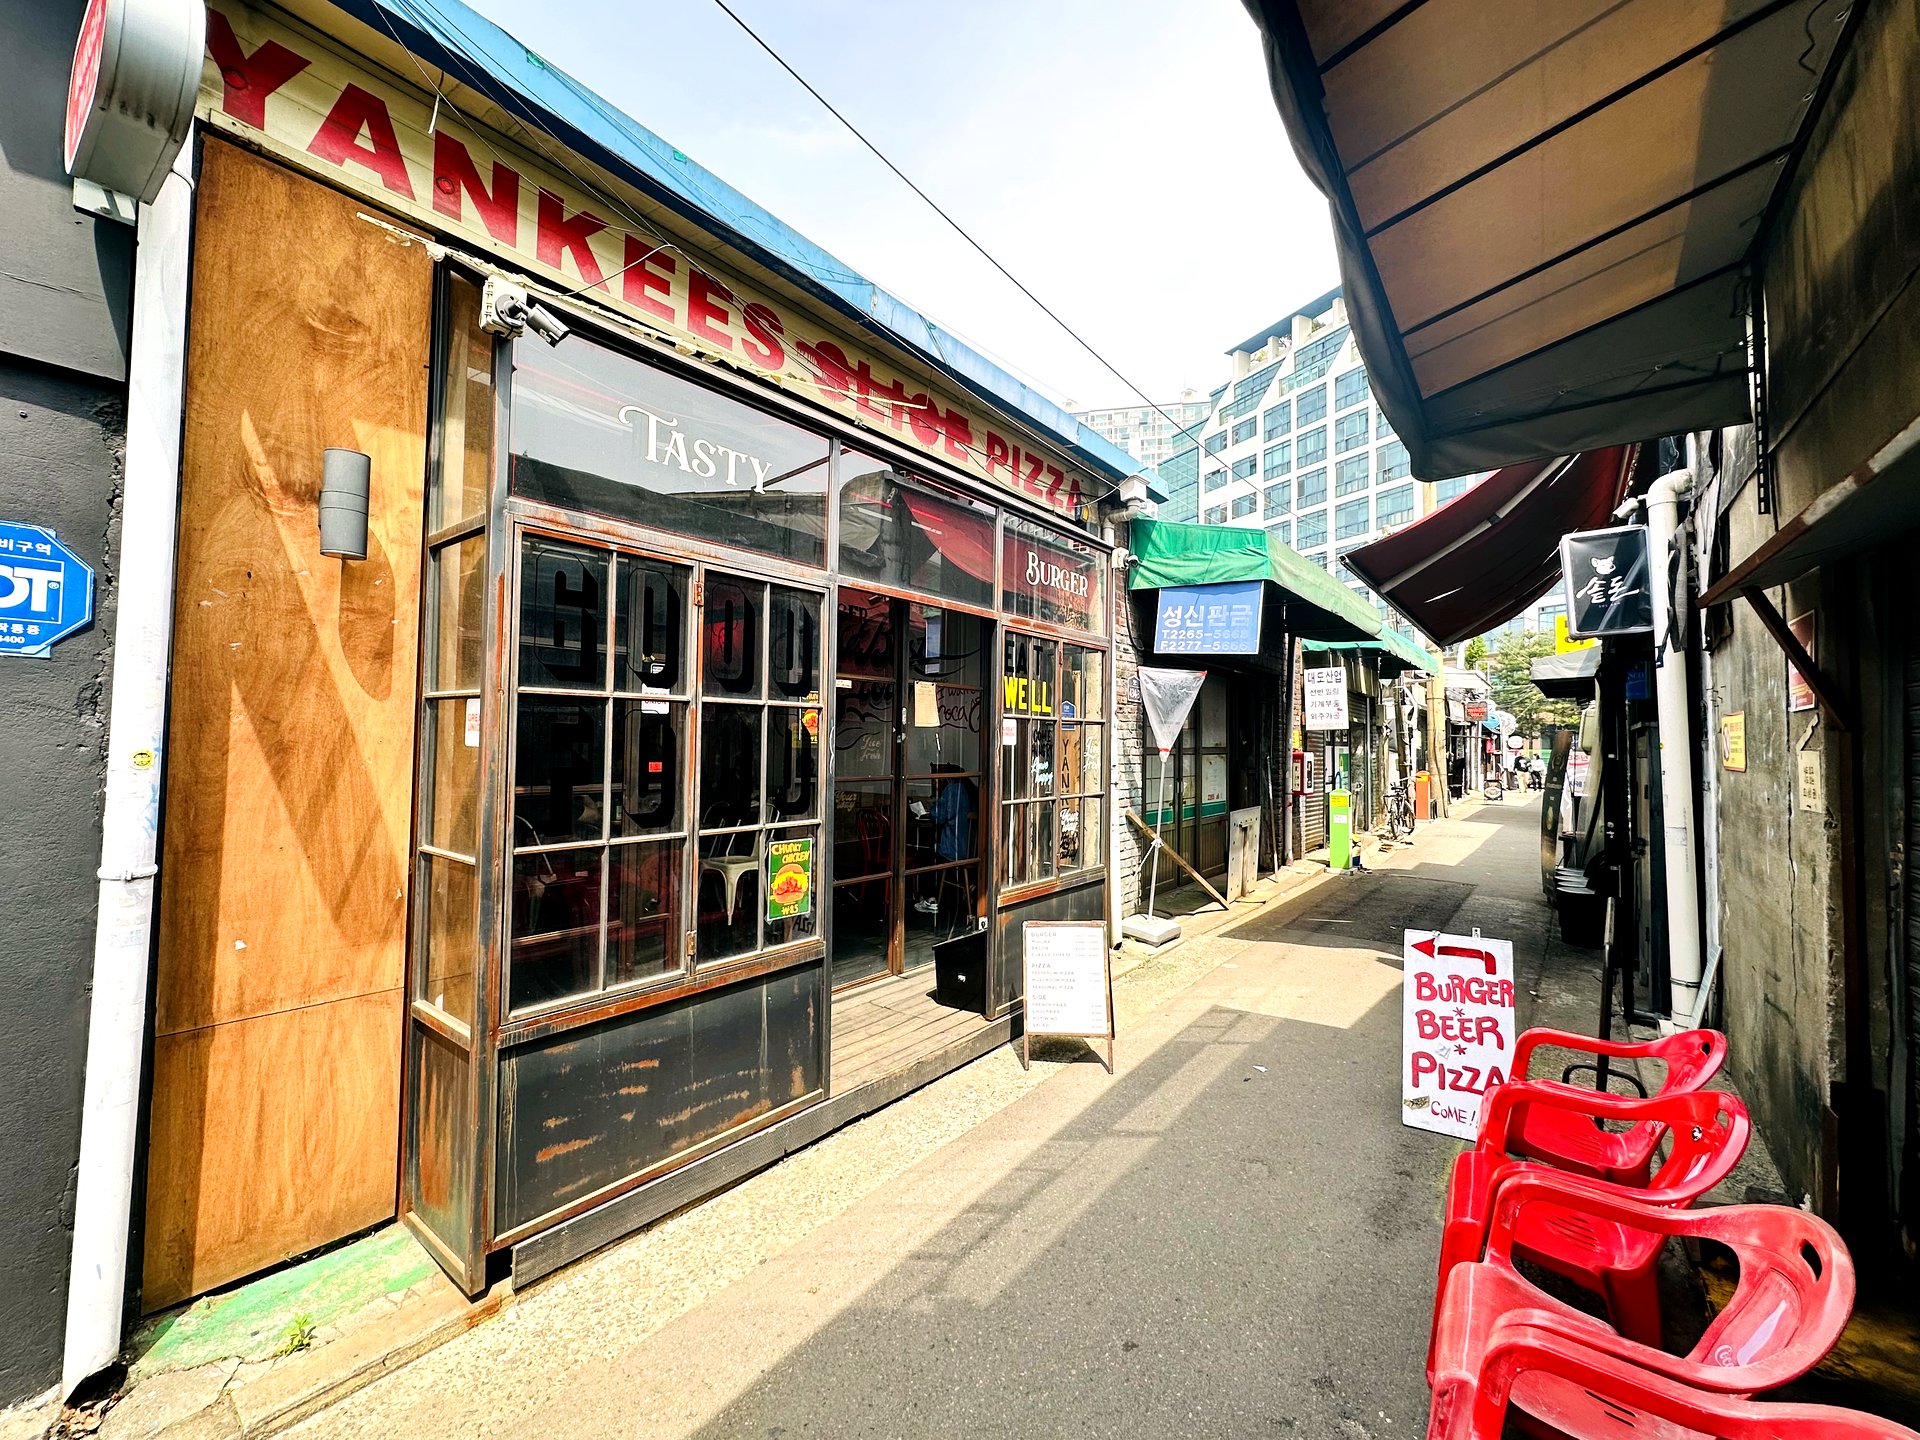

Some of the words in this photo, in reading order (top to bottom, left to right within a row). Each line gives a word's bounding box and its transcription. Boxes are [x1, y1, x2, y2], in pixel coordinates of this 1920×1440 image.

[206, 10, 785, 370] YANKEES
[985, 430, 1082, 513] PIZZA
[618, 405, 773, 495] TASTY
[1025, 550, 1089, 598] BURGER
[1162, 604, 1253, 628] 성신판금
[1004, 640, 1043, 675] EAT
[1307, 670, 1342, 684] 대도산업
[1004, 675, 1052, 712] WELL
[1414, 971, 1515, 1008] BURGER
[1415, 1009, 1505, 1051] BEER
[1411, 1051, 1505, 1096] PIZZA
